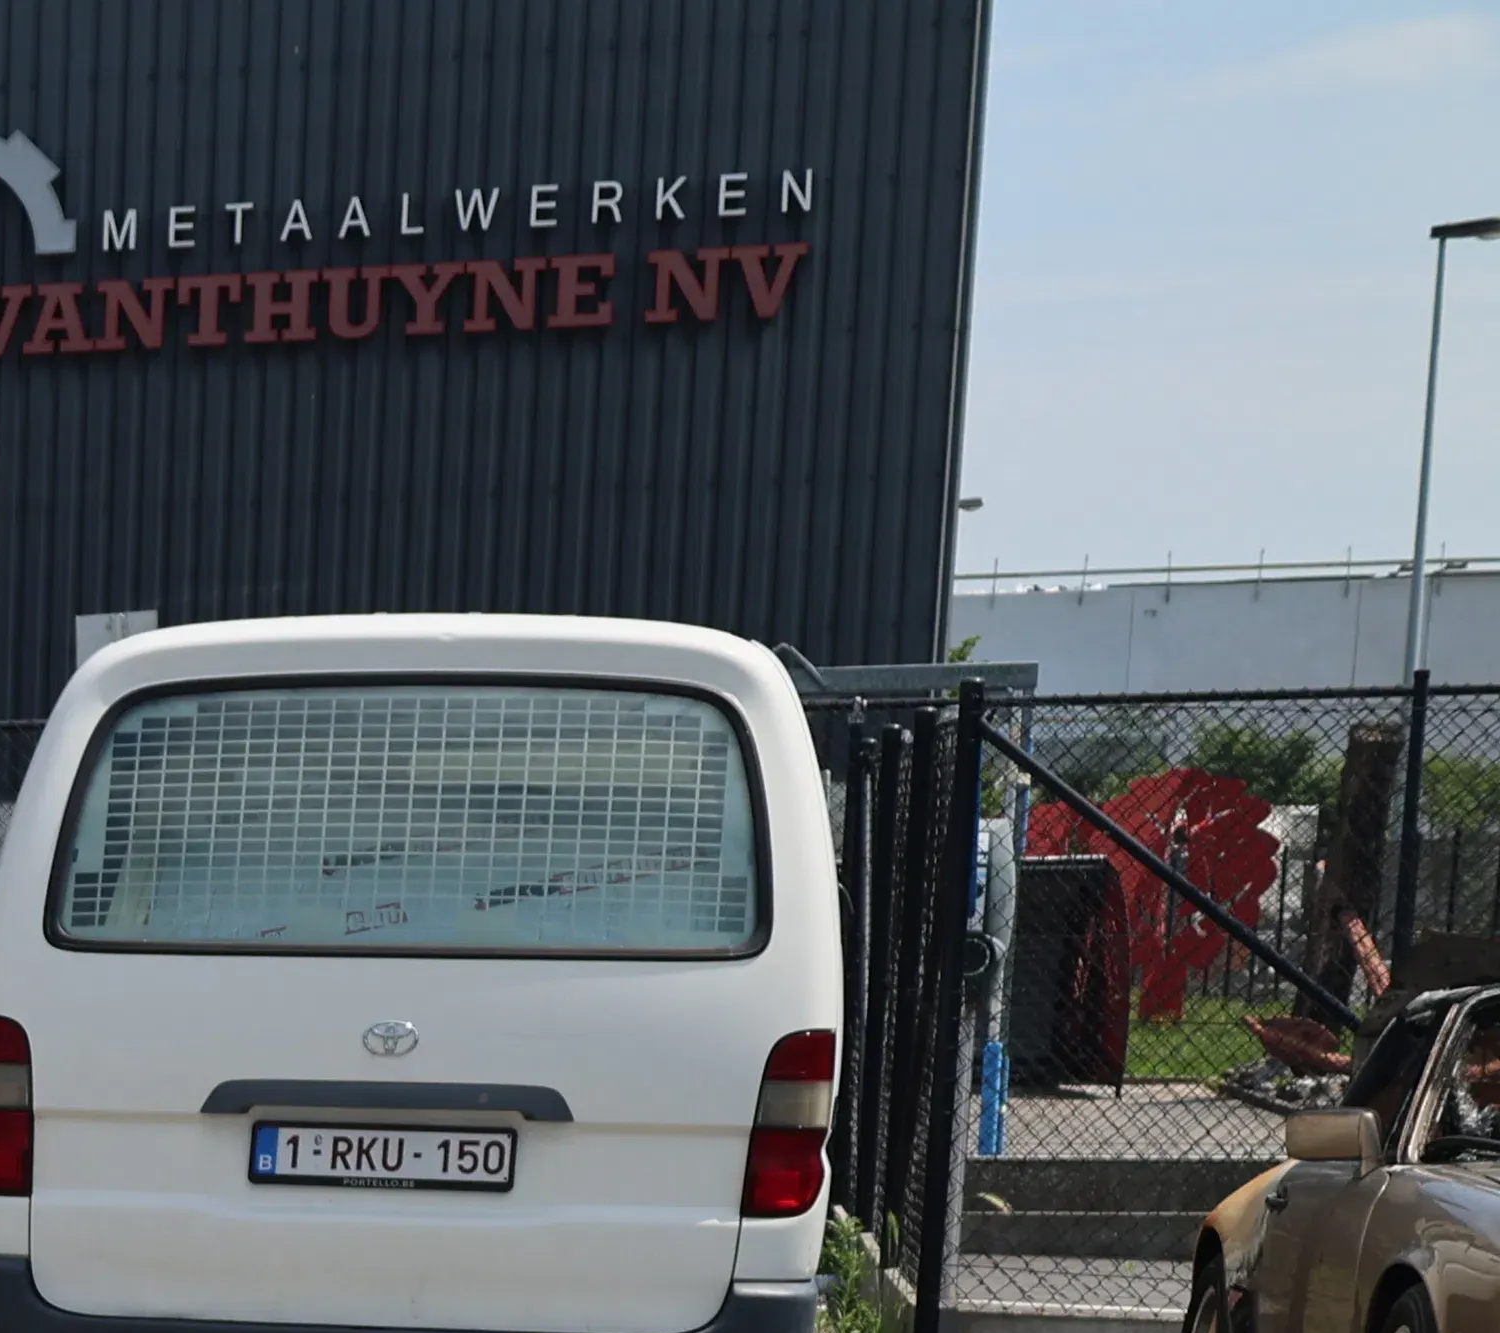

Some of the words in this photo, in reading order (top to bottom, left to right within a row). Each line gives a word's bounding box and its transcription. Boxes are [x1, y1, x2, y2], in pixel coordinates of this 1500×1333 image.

[101, 168, 814, 252] METAALWERKEN
[643, 242, 810, 324] NV
[258, 1154, 273, 1172] B
[286, 1134, 506, 1176] 1-RKU-150
[342, 1177, 416, 1189] PORTELLO.BE
